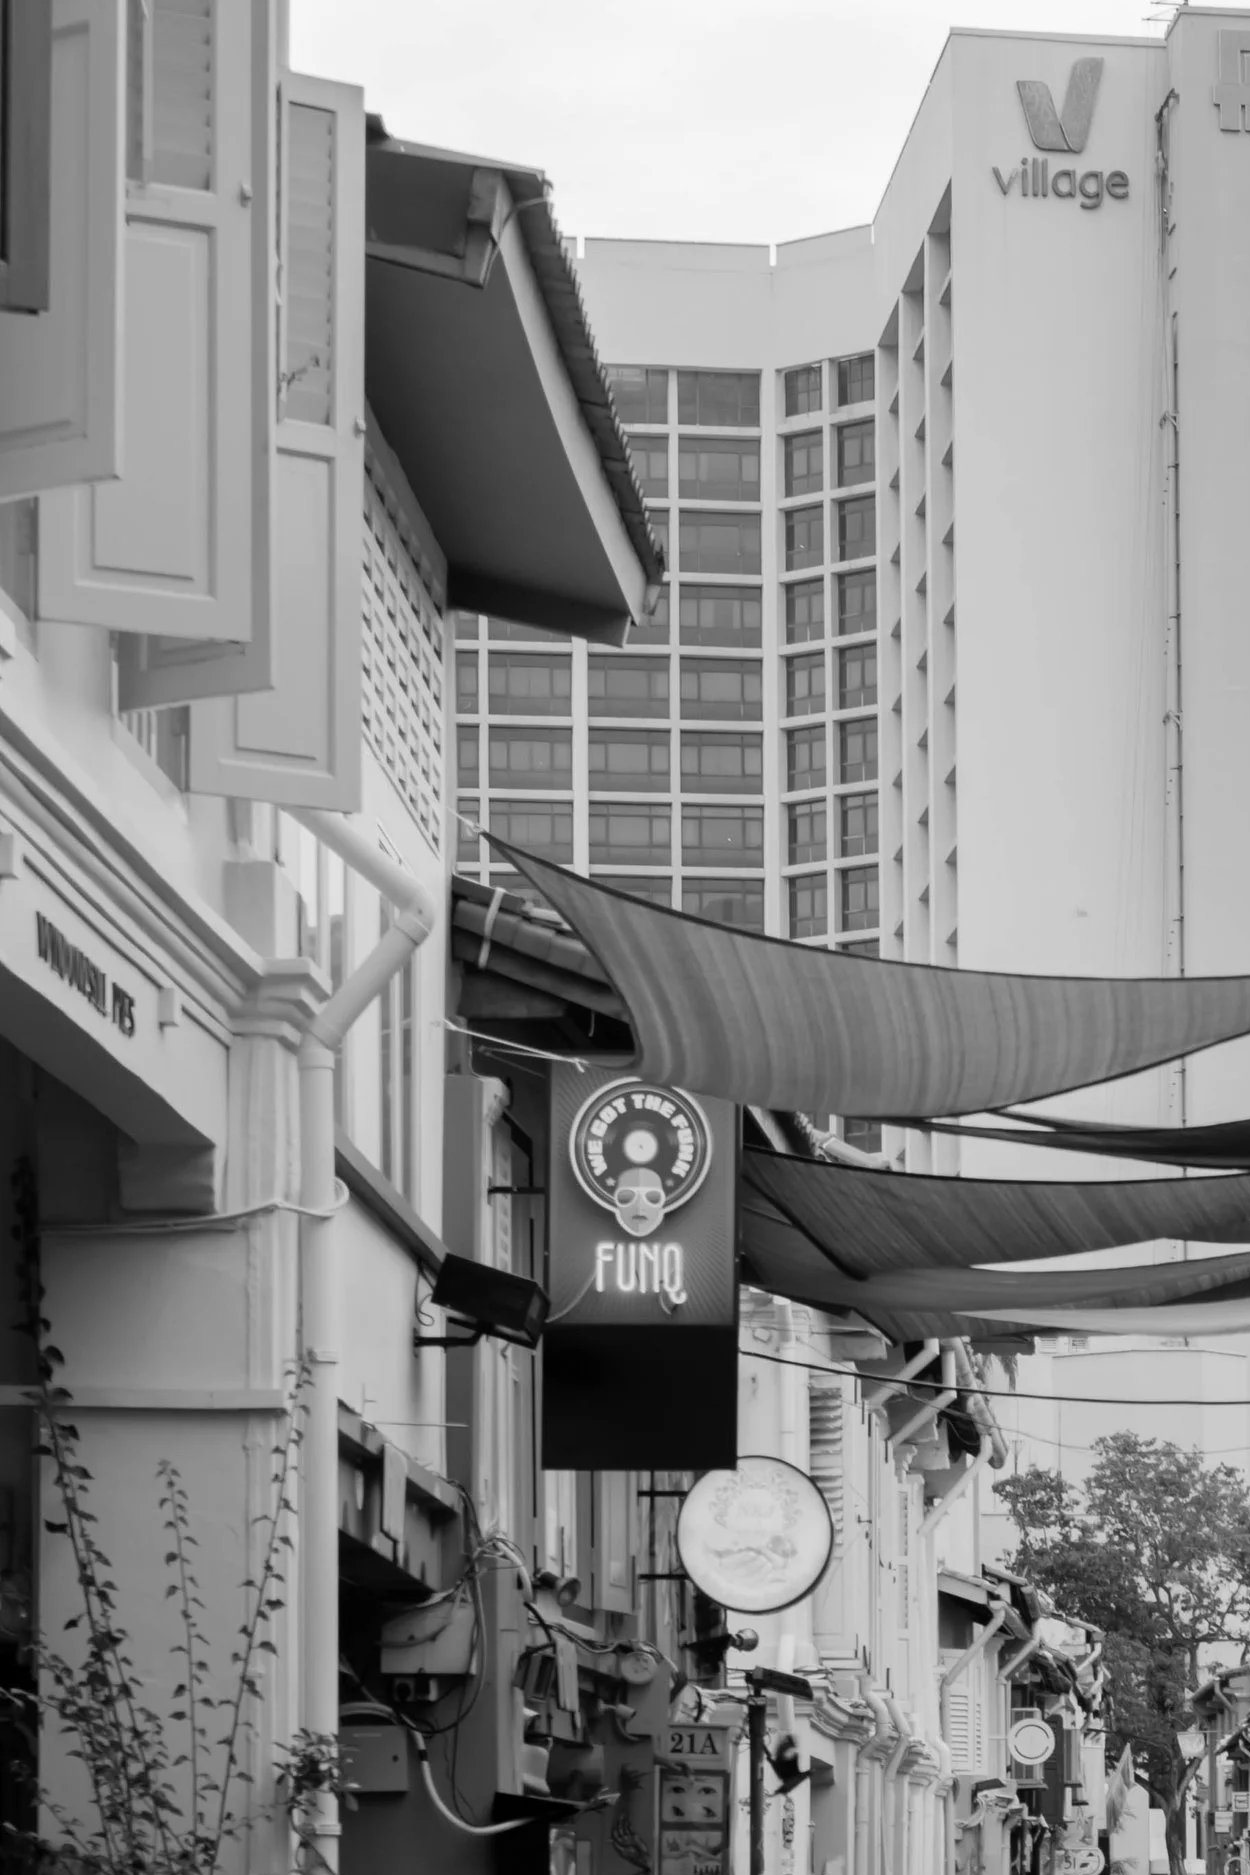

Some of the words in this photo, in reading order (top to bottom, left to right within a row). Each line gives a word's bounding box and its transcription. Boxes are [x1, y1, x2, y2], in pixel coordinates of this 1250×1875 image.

[992, 157, 1129, 210] village
[590, 1097, 628, 1137] GOT
[631, 1093, 677, 1119] THE
[587, 1139, 608, 1177] WE
[670, 1114, 695, 1178] FUNK
[595, 1240, 688, 1304] FUNQ
[669, 1732, 720, 1756] 21A
